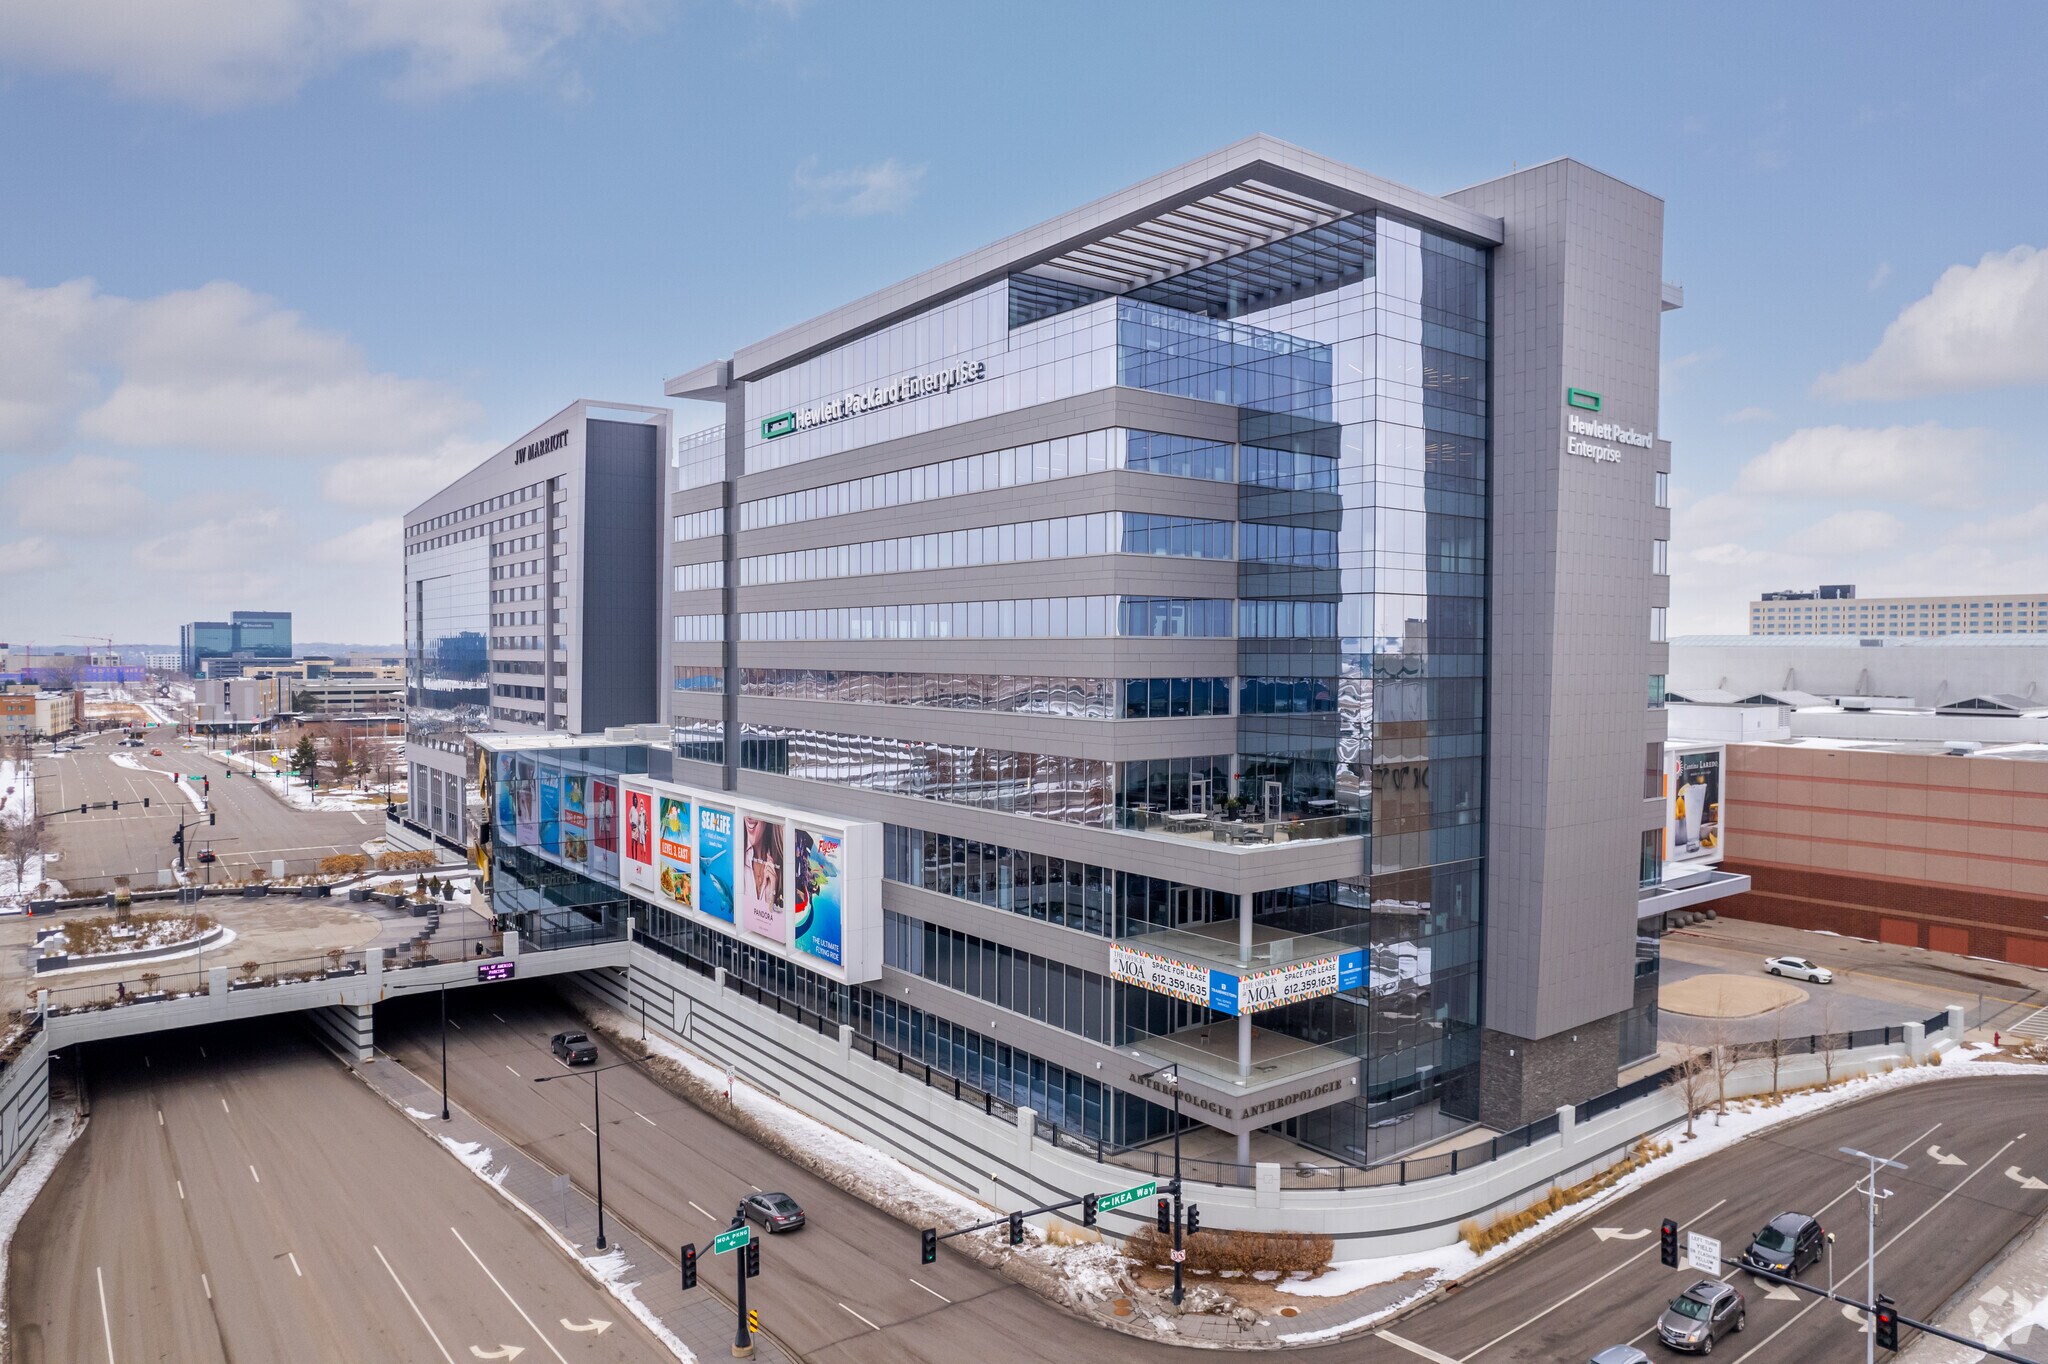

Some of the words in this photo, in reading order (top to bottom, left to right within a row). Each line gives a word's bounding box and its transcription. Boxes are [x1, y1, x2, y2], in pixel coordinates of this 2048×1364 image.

[795, 398, 843, 430] Hewlett
[844, 378, 899, 415] Packard
[900, 359, 981, 399] Enterprise
[1567, 414, 1612, 441] Hewlett
[1613, 424, 1653, 448] Packard
[514, 446, 527, 465] JW
[527, 429, 569, 461] MARRIOTT
[1567, 436, 1621, 463] Enterprise
[701, 810, 715, 831] SEA
[661, 841, 673, 856] LEVEL
[678, 846, 689, 860] EAST
[753, 907, 774, 922] PANDORA
[812, 935, 821, 945] THE
[821, 939, 840, 952] ULTIMATE
[816, 945, 829, 957] FLYING
[830, 951, 840, 961] RIDE
[1113, 950, 1124, 958] THE
[1125, 954, 1145, 965] OFFICES
[1118, 958, 1145, 979] MOA
[1152, 961, 1171, 973] SPACE
[1172, 966, 1185, 977] FOR
[1186, 971, 1207, 983] LEASE
[1284, 970, 1304, 982] SPACE
[1304, 968, 1317, 977] FOR
[1317, 963, 1336, 974] LEASE
[1152, 972, 1207, 997] 612.359.1635
[1242, 981, 1253, 990] THE
[1254, 977, 1278, 987] OFFICES
[1284, 974, 1337, 995] 612.359.1635
[1247, 984, 1277, 1004] MOA
[1241, 1079, 1342, 1120] ANTHROPOLOGIE
[1111, 1193, 1132, 1207] IKEA
[1136, 1185, 1155, 1200] Way
[717, 1235, 730, 1244] MOA
[731, 1229, 748, 1239] PKNG
[1696, 1242, 1713, 1253] YIELD
[1695, 1255, 1714, 1265] YELLOW
